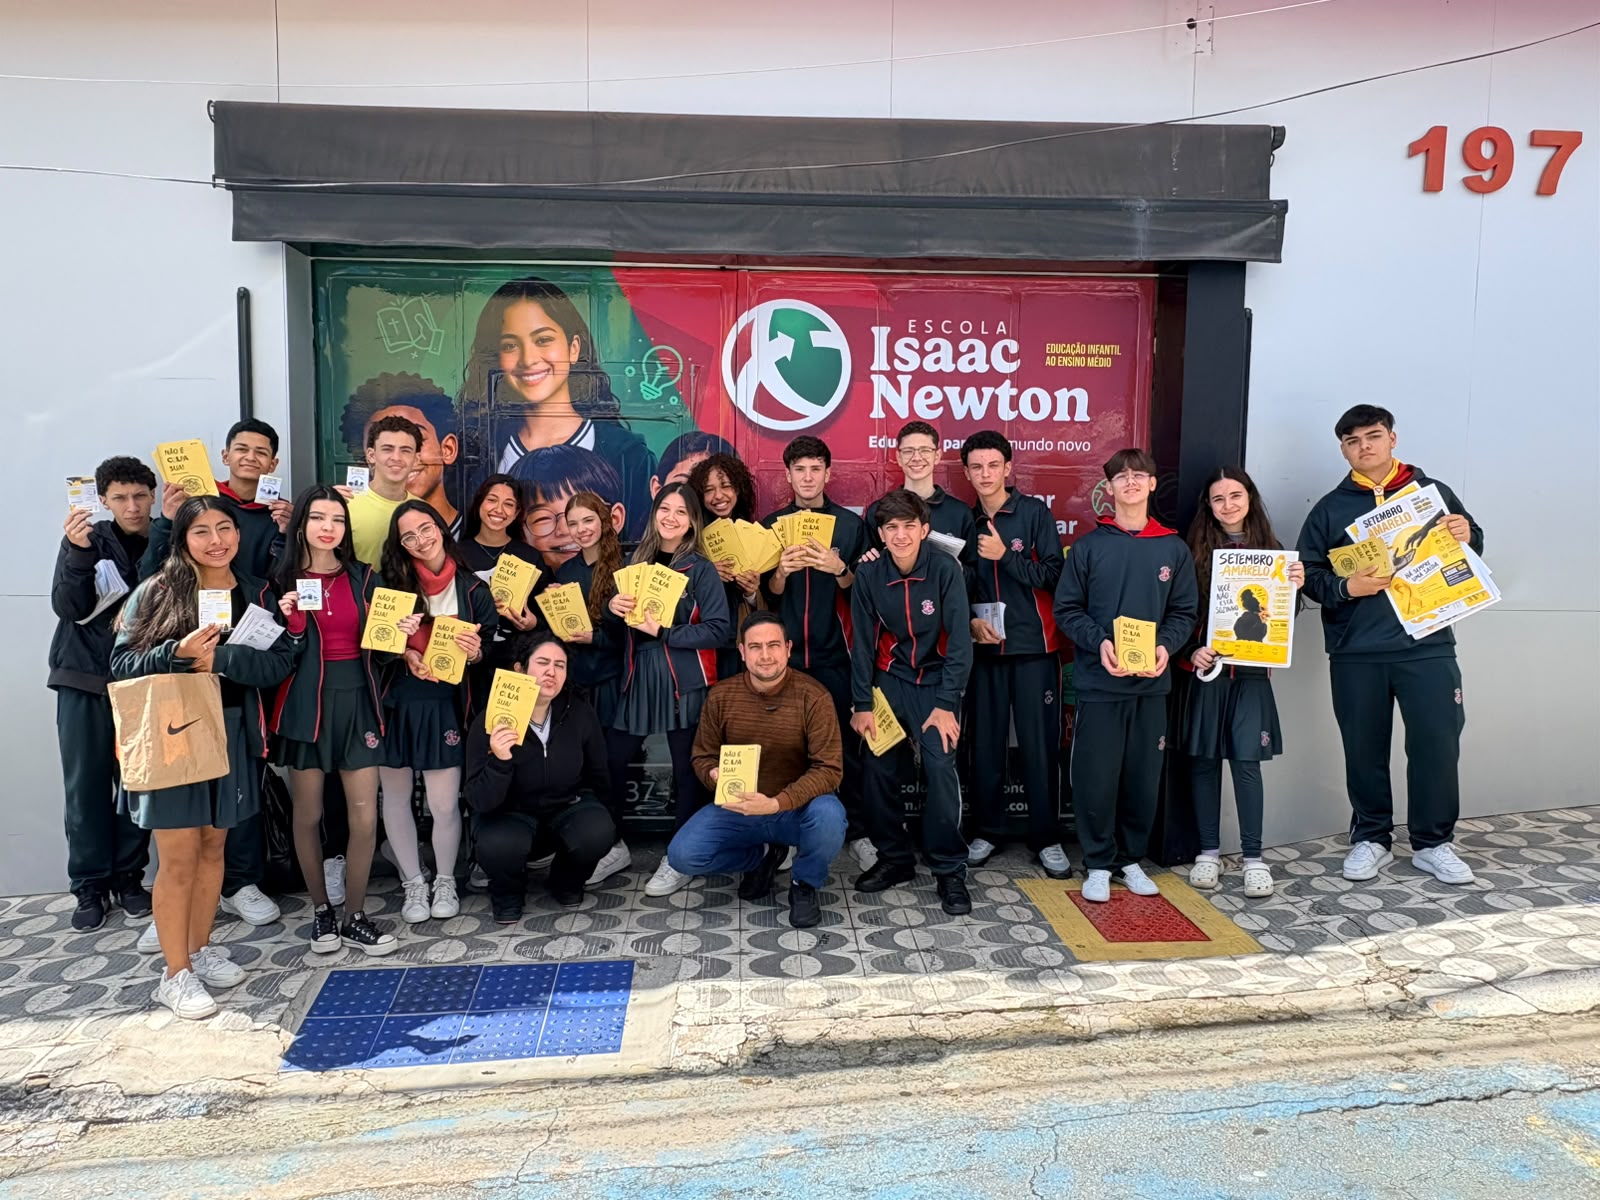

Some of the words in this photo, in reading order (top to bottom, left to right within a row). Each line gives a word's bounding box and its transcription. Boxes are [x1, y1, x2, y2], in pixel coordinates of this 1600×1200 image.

[1408, 126, 1583, 196] 197
[908, 319, 1007, 335] ESCOLA
[870, 326, 1021, 373] Isaac
[1046, 342, 1086, 356] EDUCAÇÃO
[1087, 344, 1122, 356] INFANTIL
[1045, 356, 1057, 367] AO
[1057, 356, 1086, 367] ENSINO
[1087, 355, 1112, 368] MÉDIO
[869, 374, 1091, 422] Newton
[943, 439, 964, 452] par
[1009, 437, 1054, 451] mundo
[1057, 441, 1091, 452] novo
[1362, 504, 1403, 529] SETEMBRO
[1368, 512, 1413, 538] AMARELO
[1219, 553, 1273, 567] SETEMBRO
[1219, 565, 1271, 576] AMARELO
[375, 602, 396, 611] CLA
